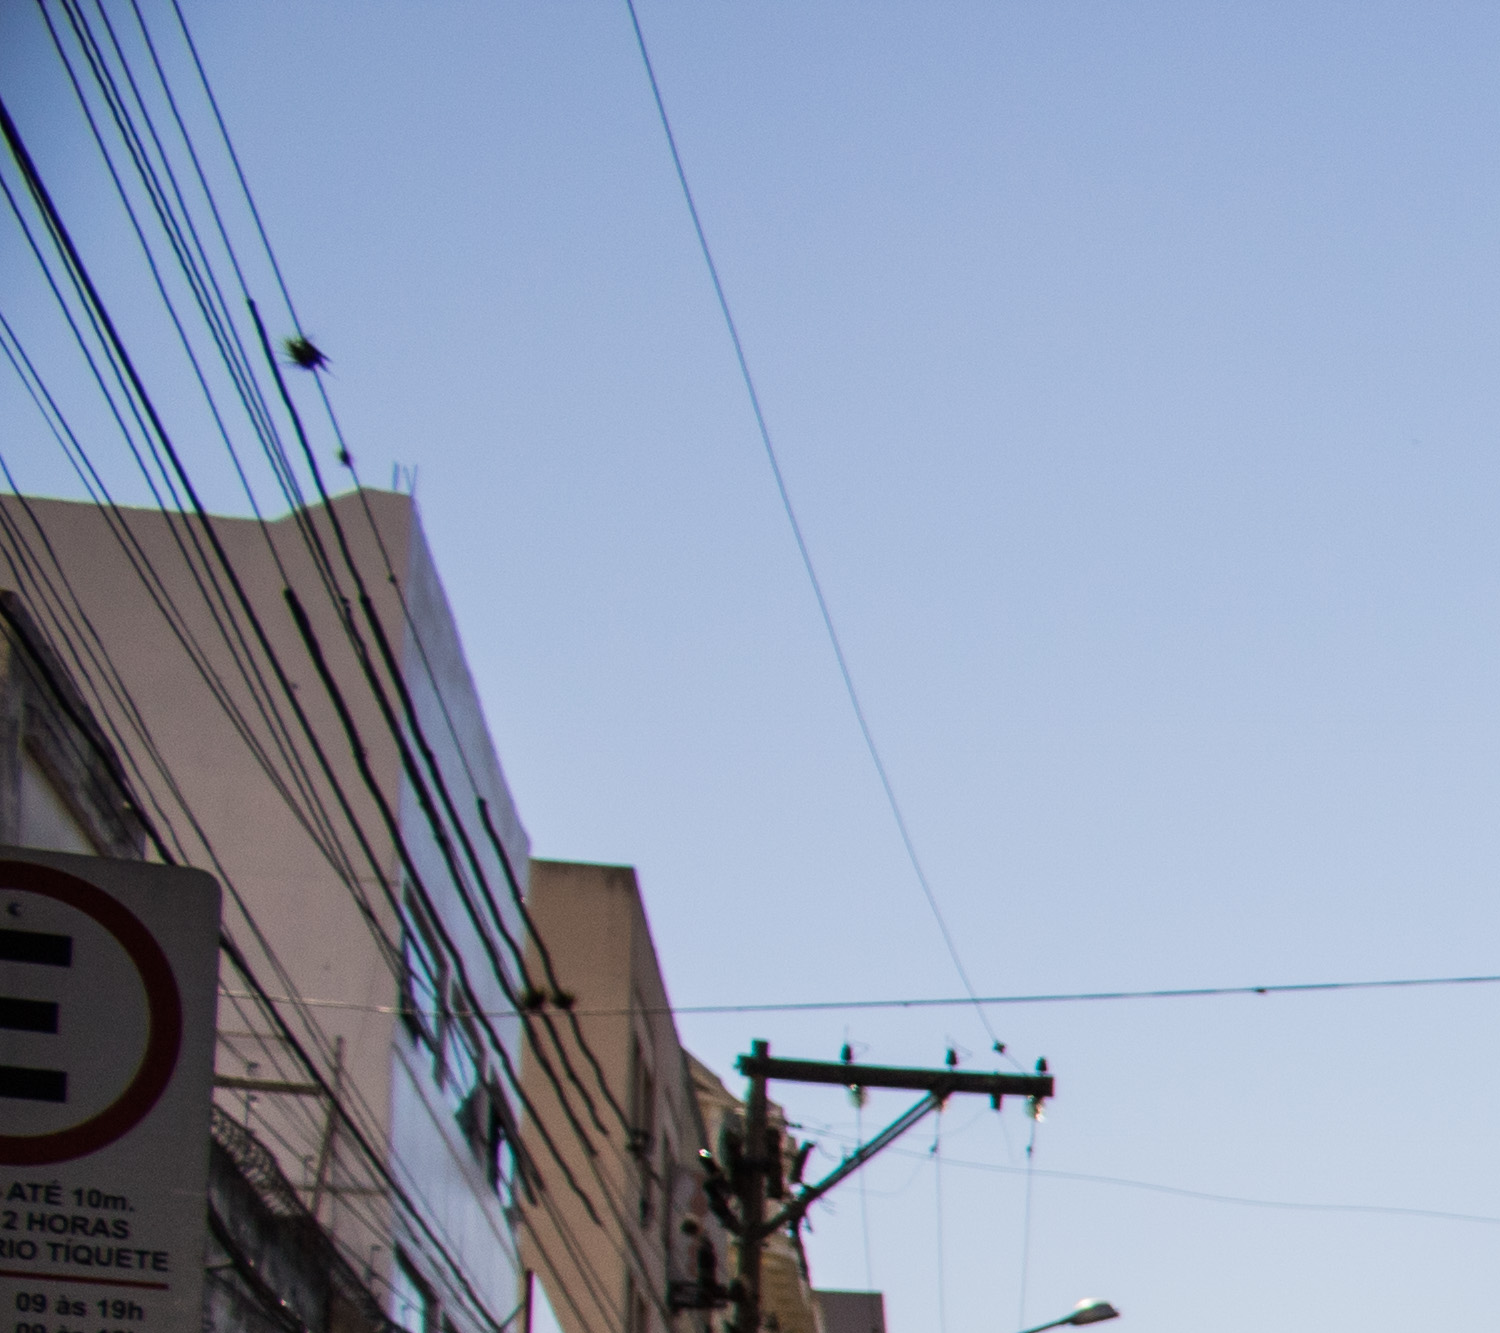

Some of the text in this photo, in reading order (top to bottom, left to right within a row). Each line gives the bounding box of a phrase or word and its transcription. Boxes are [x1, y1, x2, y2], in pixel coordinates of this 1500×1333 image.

[8, 1179, 136, 1212] ATÉ 10m.
[2, 1210, 130, 1240] 2 HORAS
[47, 1240, 170, 1273] TÍQUETE
[16, 1292, 145, 1321] 09 às 19h
